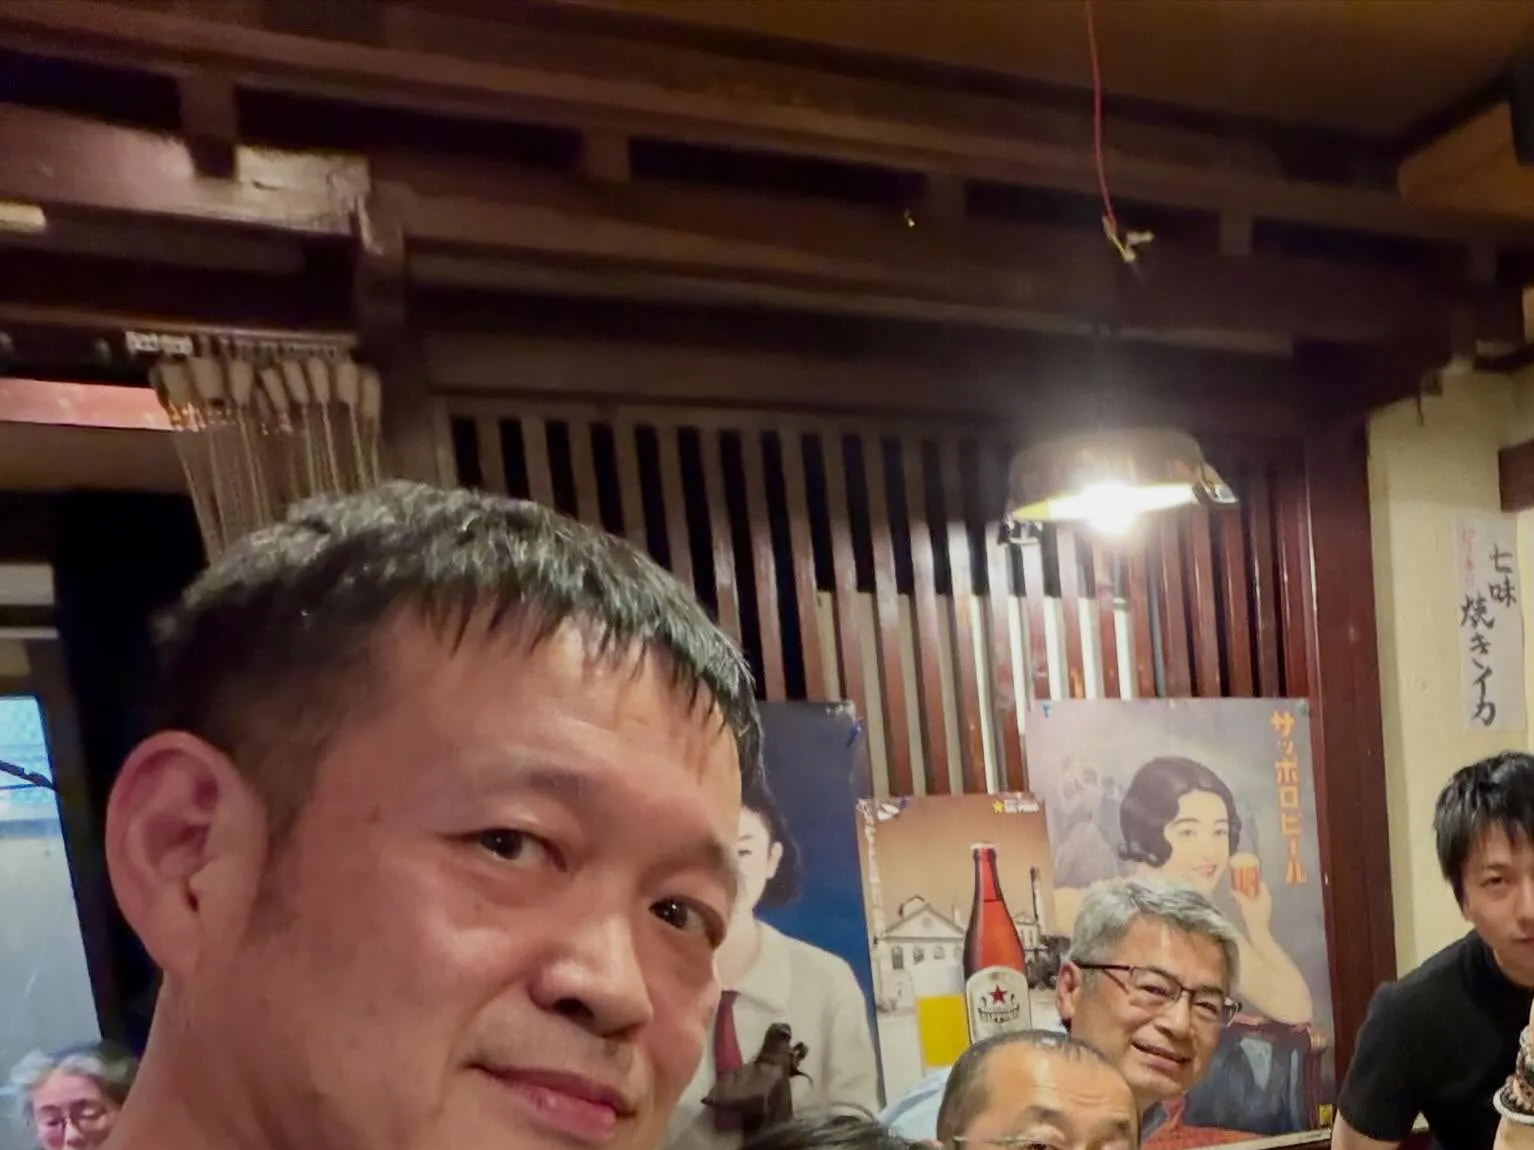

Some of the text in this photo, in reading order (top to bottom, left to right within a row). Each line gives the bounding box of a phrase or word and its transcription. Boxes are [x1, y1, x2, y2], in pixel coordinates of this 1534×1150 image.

[1460, 591, 1497, 728] 焼きイカ
[1270, 710, 1308, 885] サッポロビール
